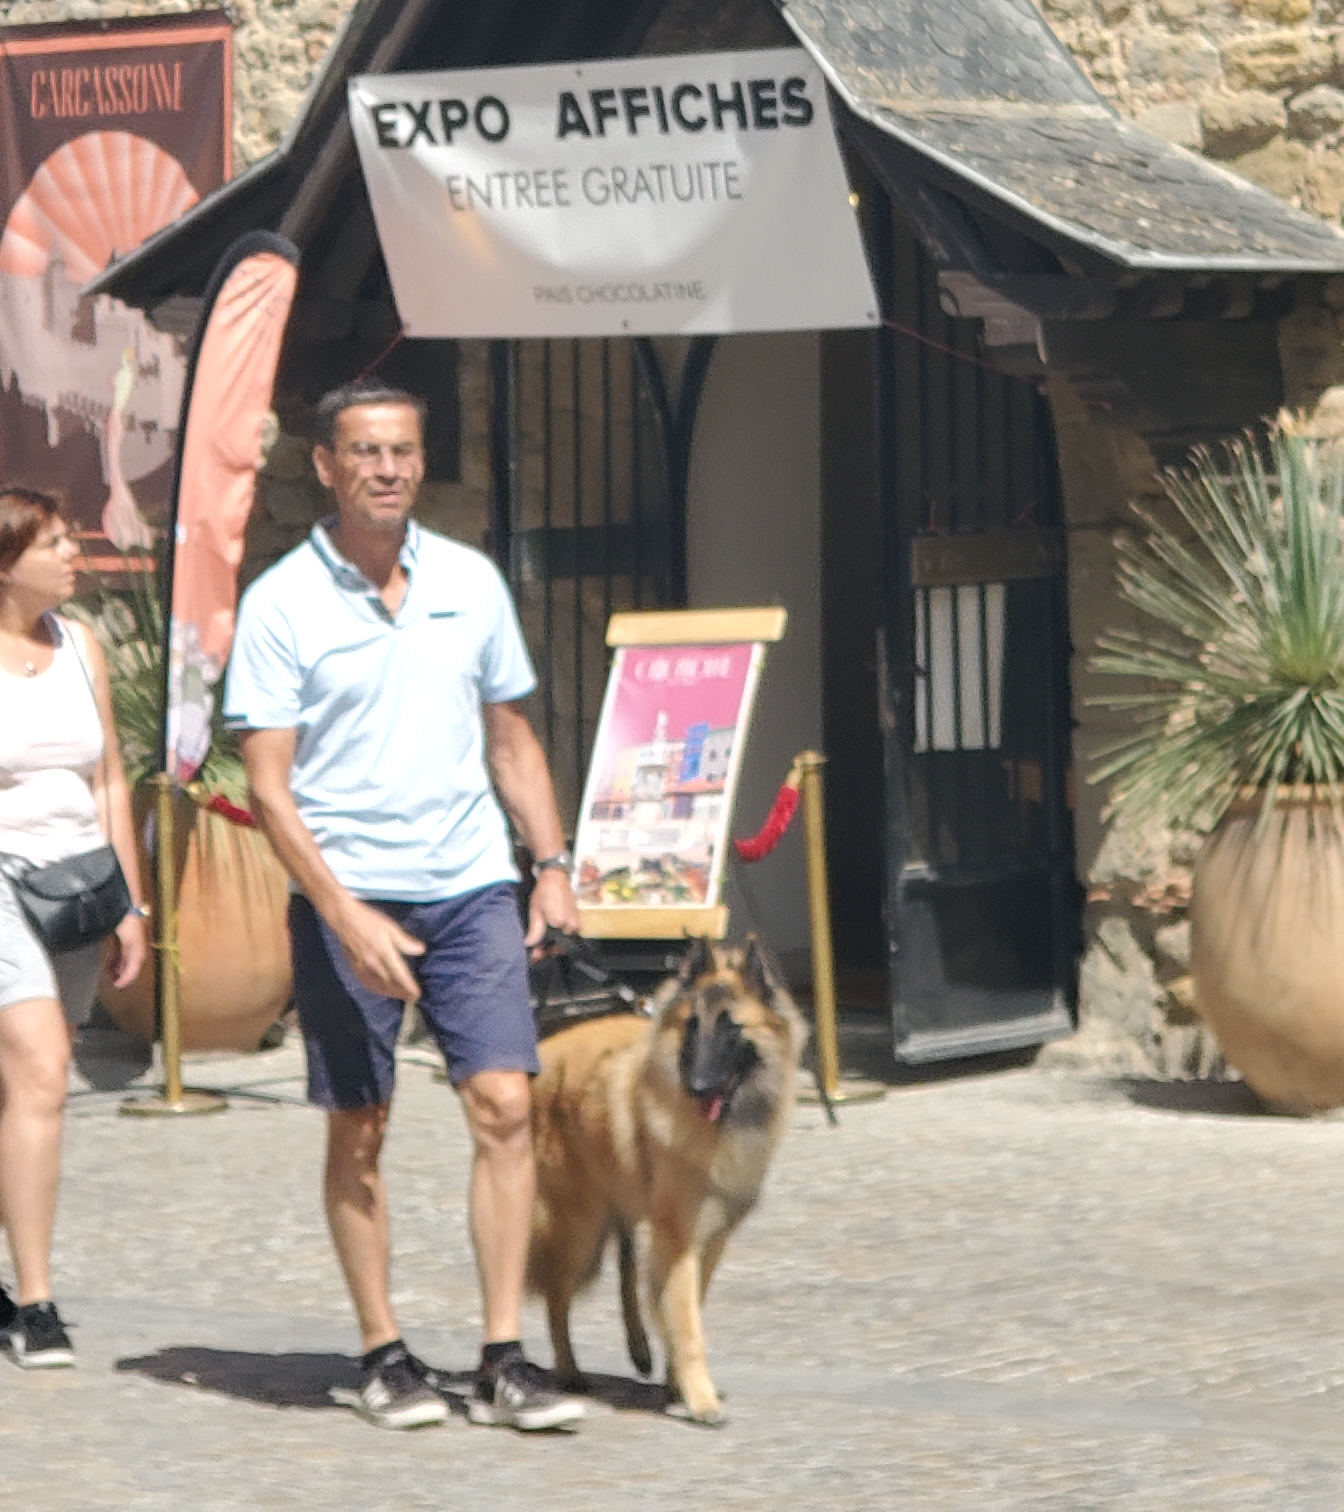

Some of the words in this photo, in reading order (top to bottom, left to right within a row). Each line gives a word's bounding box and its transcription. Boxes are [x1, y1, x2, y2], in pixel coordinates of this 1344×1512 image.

[371, 95, 511, 149] EXPO
[557, 77, 815, 140] AFFICHES
[446, 167, 573, 211] ENTREE
[581, 160, 744, 205] GRATUITE
